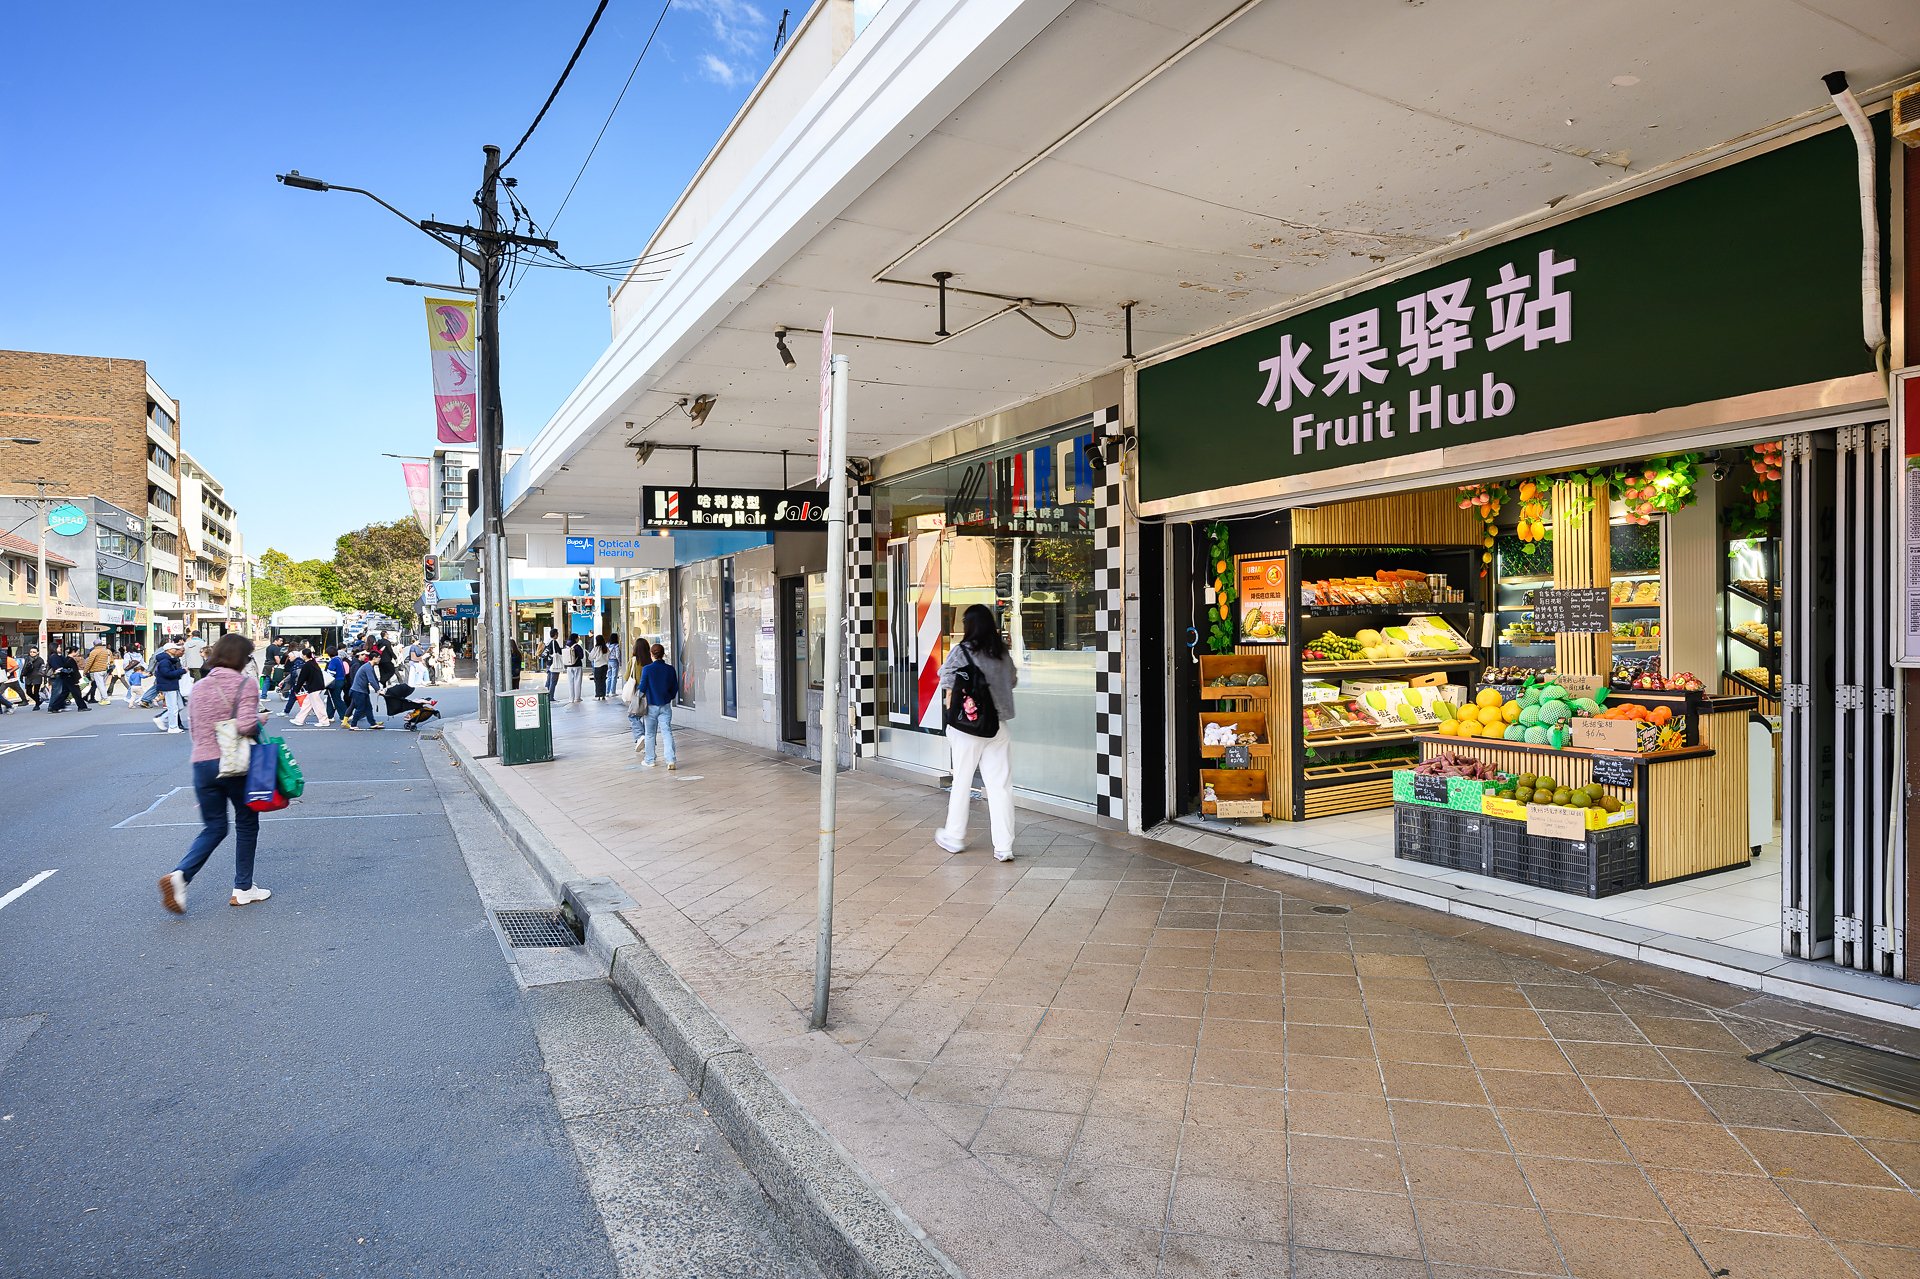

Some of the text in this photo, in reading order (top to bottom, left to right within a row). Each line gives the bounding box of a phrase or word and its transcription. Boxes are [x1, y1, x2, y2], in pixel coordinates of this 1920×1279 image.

[1257, 249, 1577, 412] 水果驿站
[1293, 372, 1516, 456] Fruit Hub
[997, 433, 1095, 516] HAIR CU
[697, 494, 760, 510] 哈利发型
[692, 510, 733, 528] Harry
[735, 511, 767, 525] Hair
[566, 538, 583, 546] Bupa
[598, 539, 641, 549] Optical &
[599, 549, 634, 558] Hearing
[171, 601, 196, 609] 71-73
